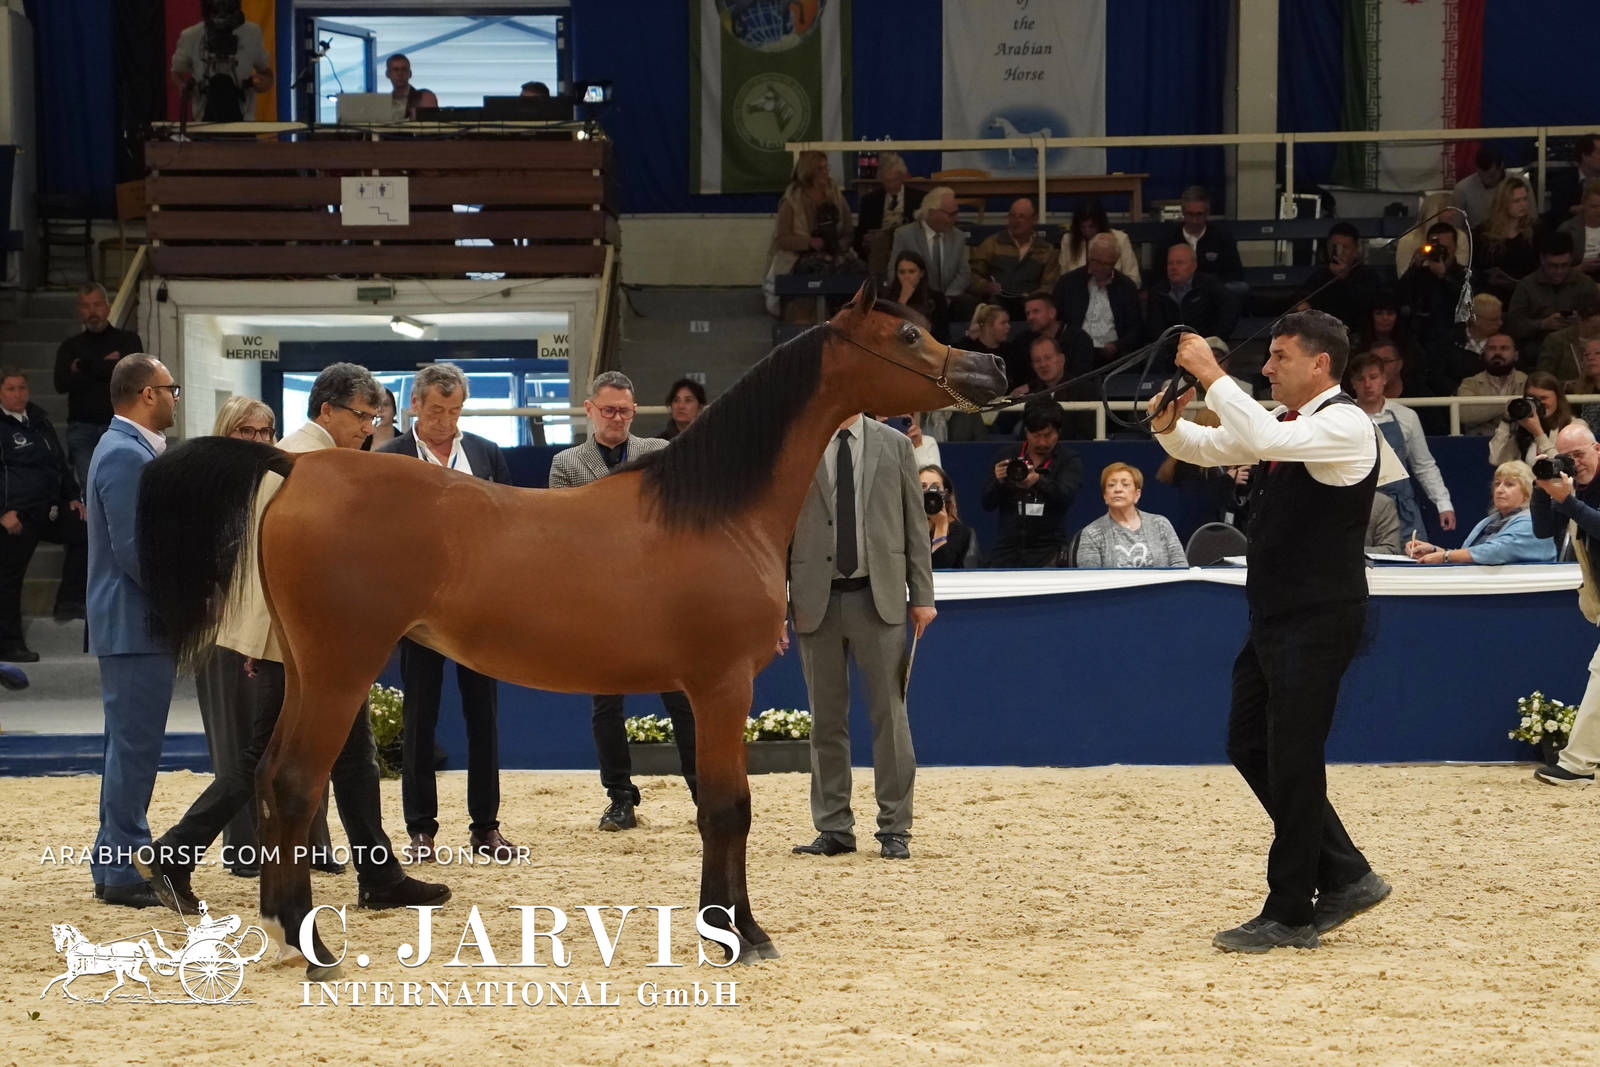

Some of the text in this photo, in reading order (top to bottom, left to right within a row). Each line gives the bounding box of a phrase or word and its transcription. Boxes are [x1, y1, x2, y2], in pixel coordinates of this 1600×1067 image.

[1013, 15, 1036, 29] the
[994, 41, 1052, 55] Arabian
[1004, 66, 1045, 81] Horse
[242, 335, 263, 346] WC
[226, 349, 278, 359] HERREN
